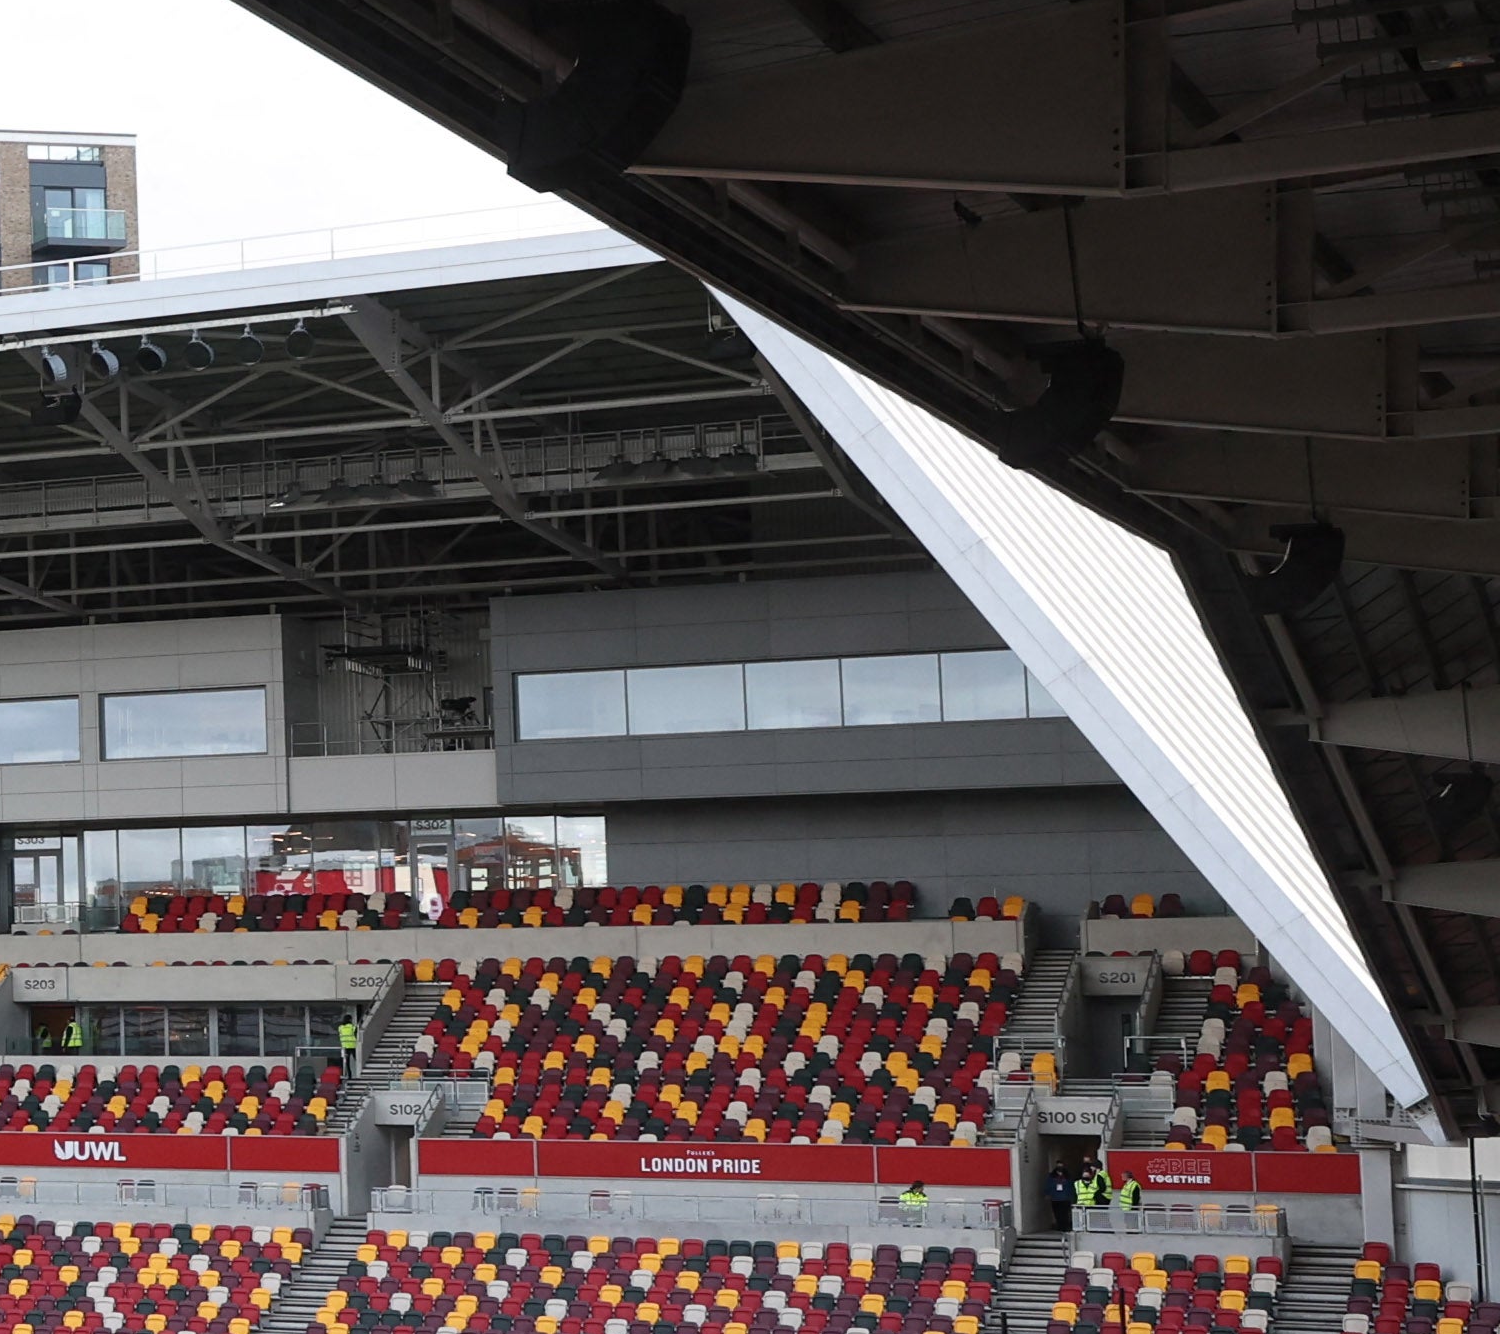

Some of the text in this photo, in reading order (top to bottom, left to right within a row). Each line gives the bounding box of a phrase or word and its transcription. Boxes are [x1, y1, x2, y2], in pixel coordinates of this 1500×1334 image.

[415, 819, 448, 830] S302
[350, 977, 383, 988] S202
[1099, 972, 1137, 983] S201
[24, 979, 56, 990] S203
[389, 1104, 422, 1115] S102
[1037, 1111, 1077, 1124] S100
[640, 1157, 762, 1175] LONDON PRIDE
[1146, 1158, 1212, 1175] #BEE
[1148, 1174, 1211, 1185] TOGETHER
